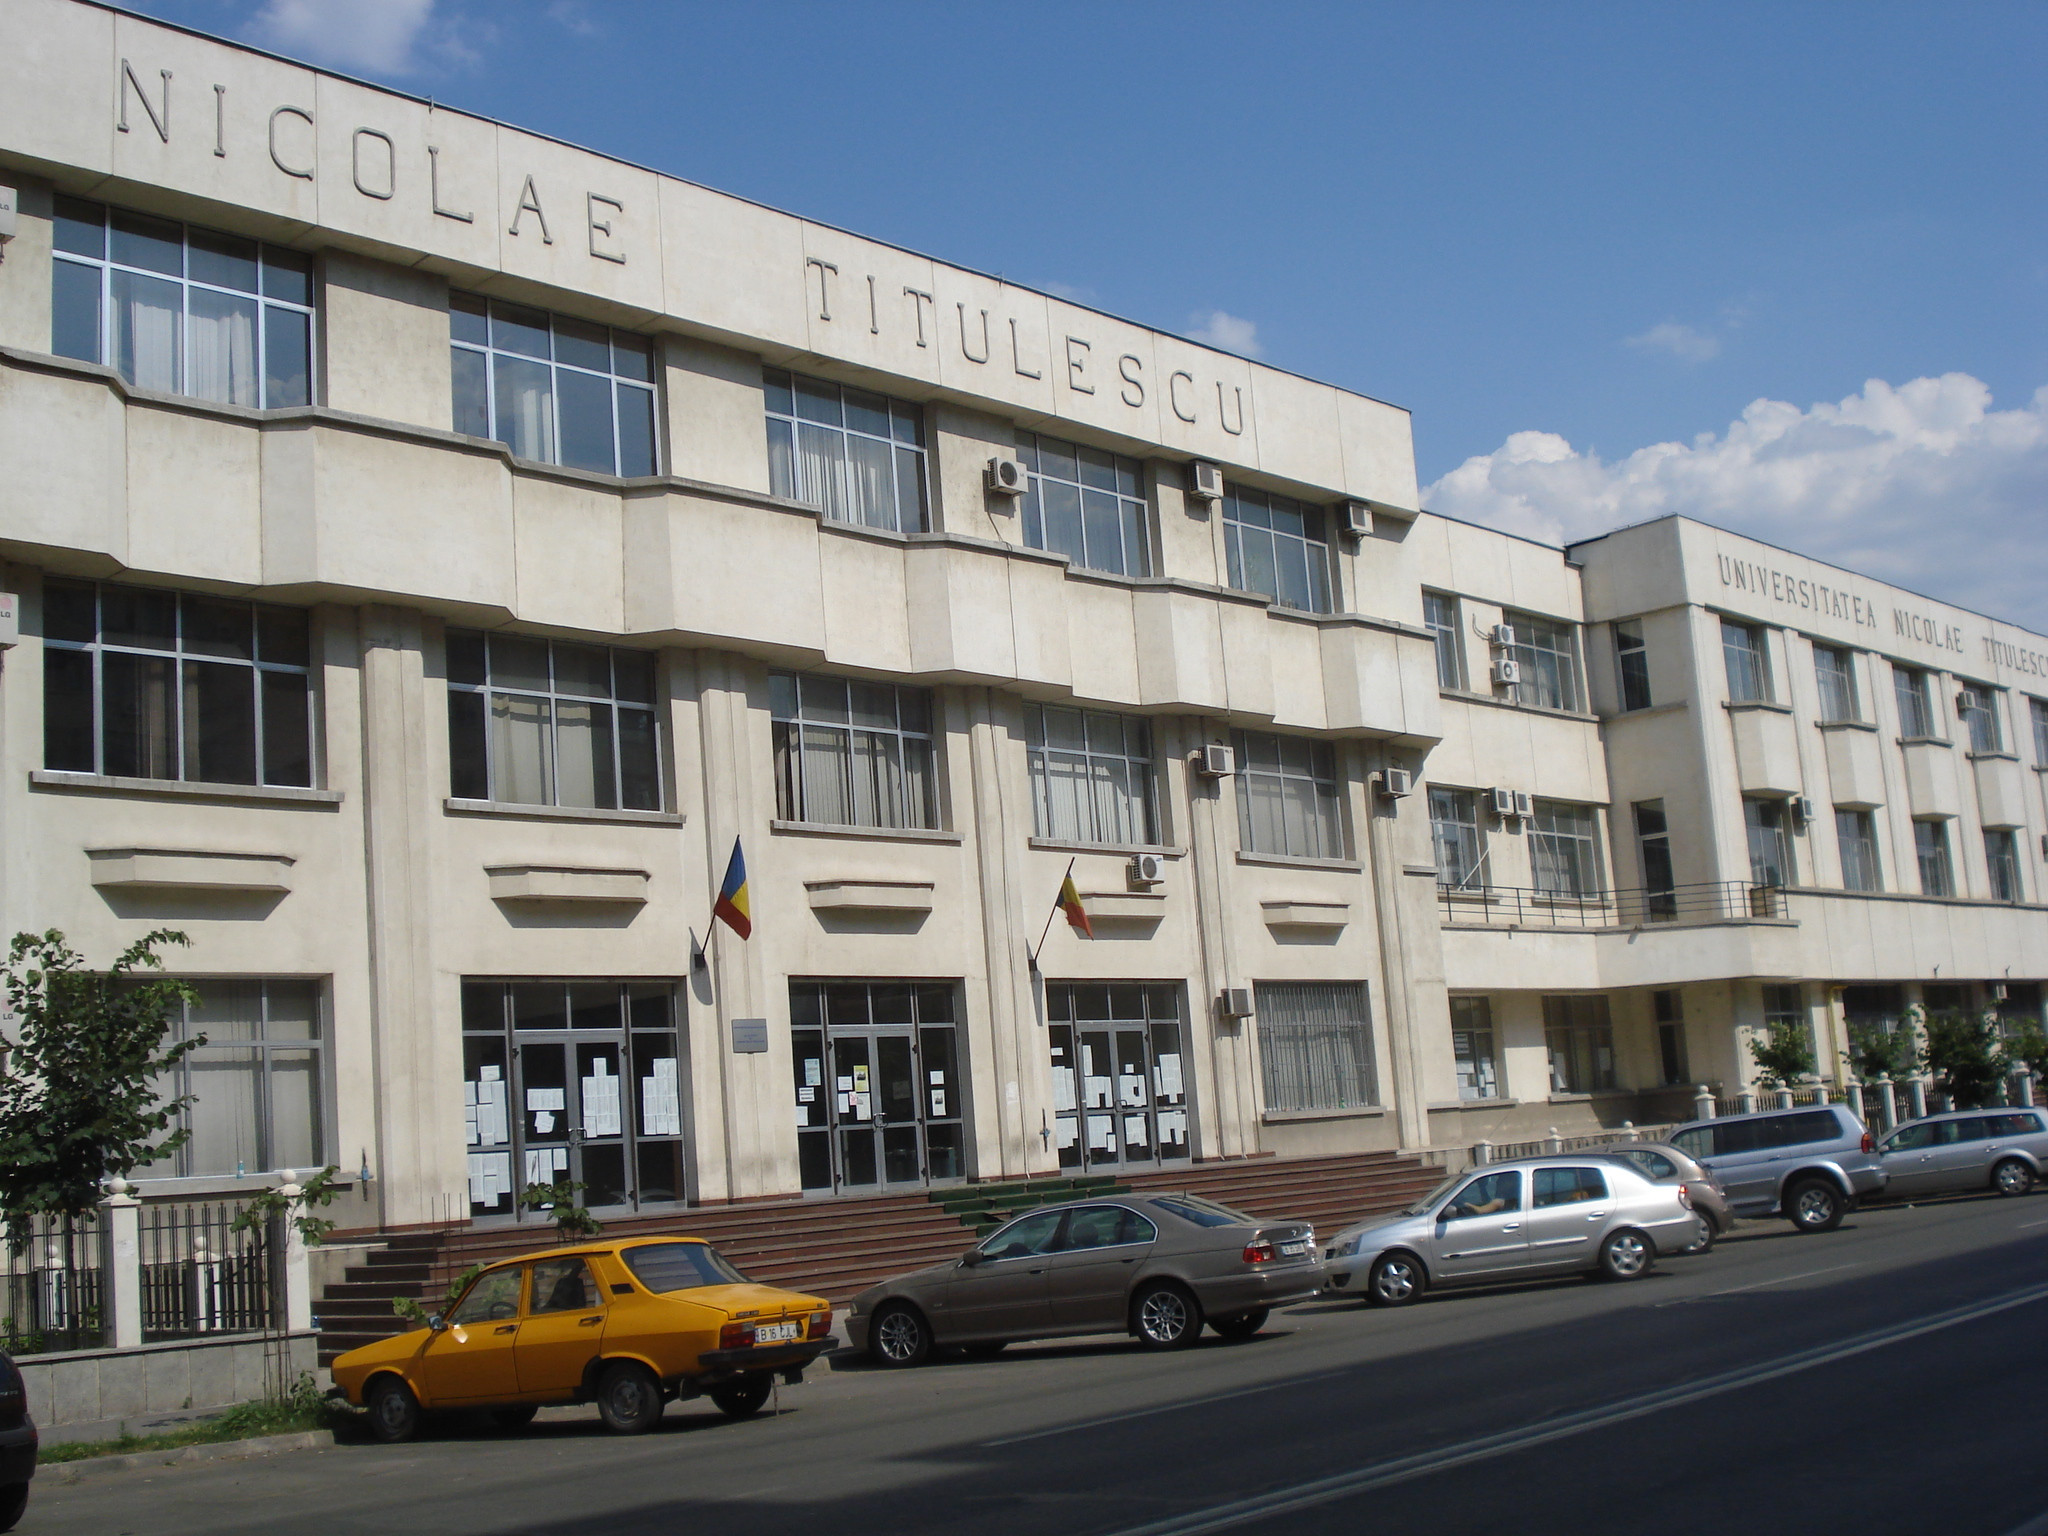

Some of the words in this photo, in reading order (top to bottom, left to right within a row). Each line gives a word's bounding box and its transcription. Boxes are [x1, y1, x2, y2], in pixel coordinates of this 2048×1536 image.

[117, 58, 626, 264] NICOLAE
[806, 256, 1243, 435] TITULESCU
[1718, 553, 1877, 628] UNIVERSITATEA
[1893, 608, 1964, 653] NICOLAE
[1982, 636, 2048, 678] TITULESC
[760, 1328, 767, 1340] B
